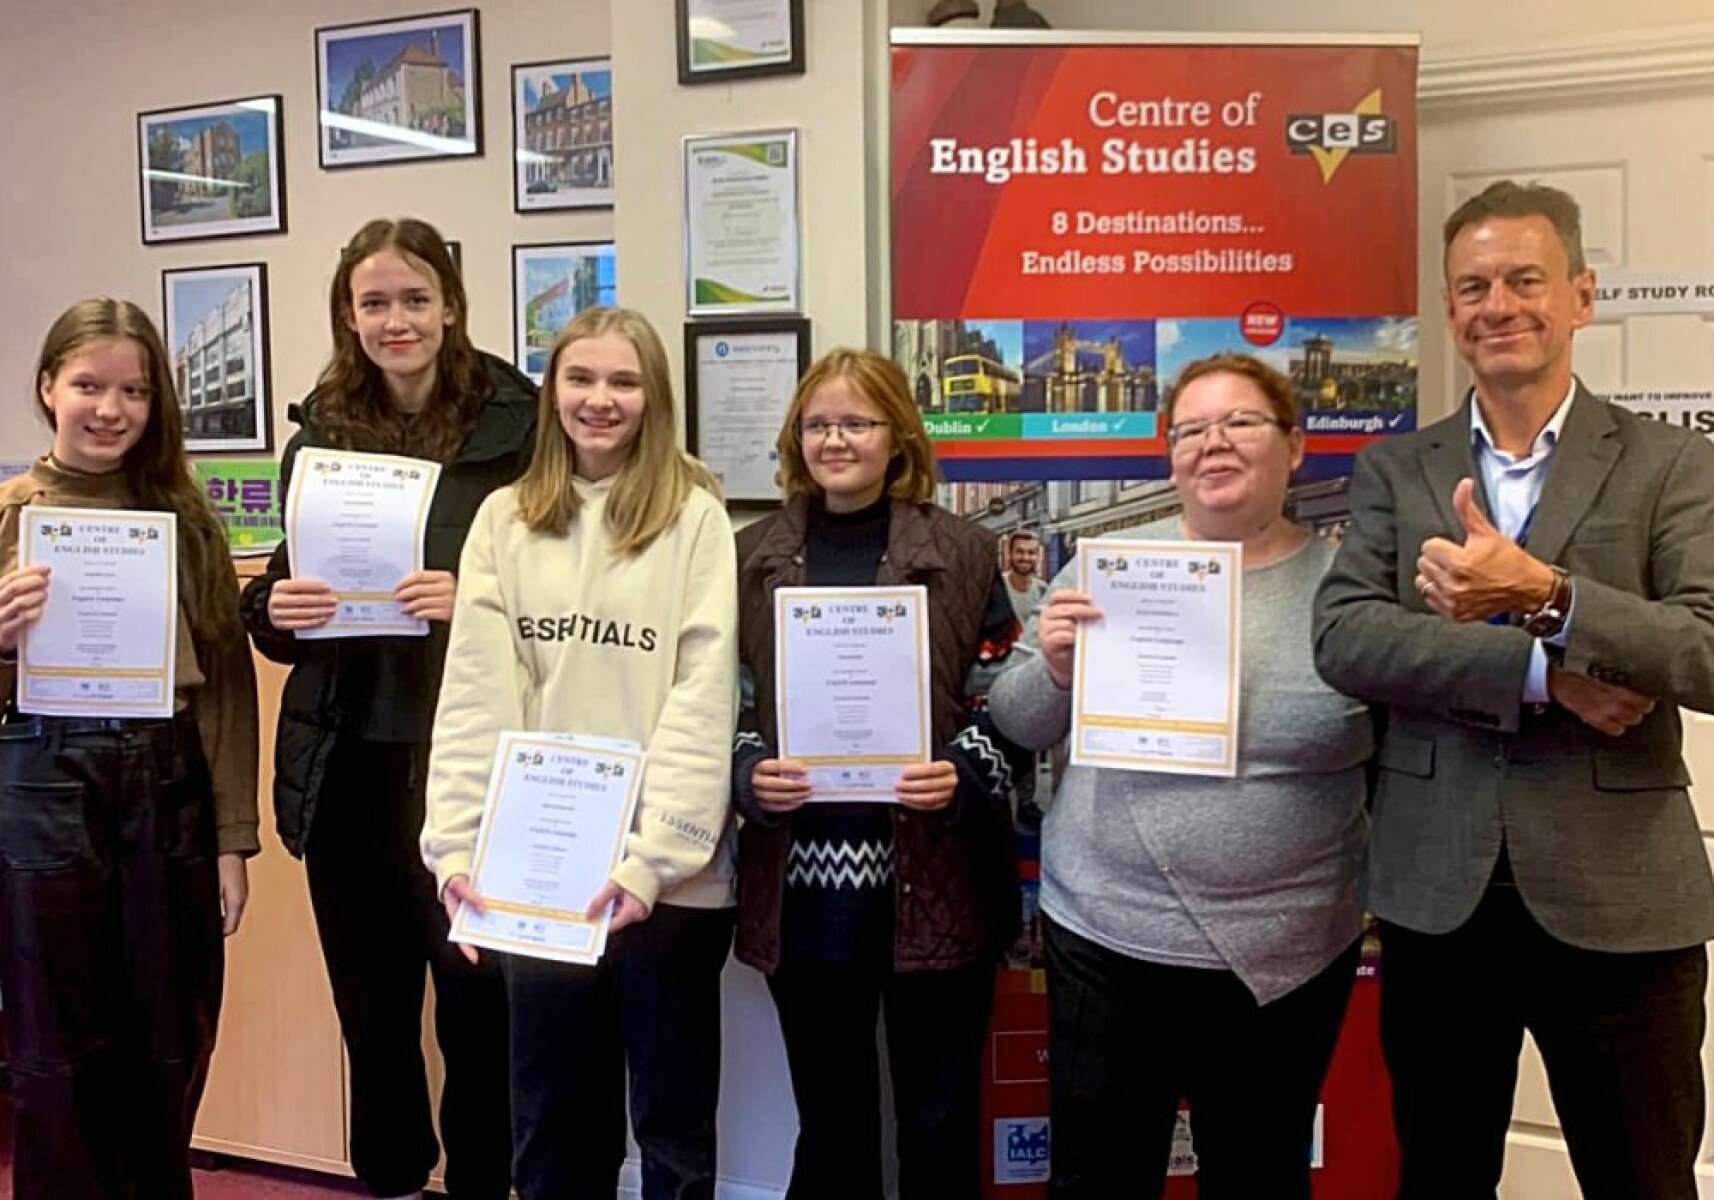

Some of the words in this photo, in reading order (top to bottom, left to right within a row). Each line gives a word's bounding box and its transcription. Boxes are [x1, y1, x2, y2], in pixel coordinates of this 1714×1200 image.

[1089, 92, 1210, 127] Centre
[1222, 92, 1261, 127] of
[1287, 119, 1388, 143] ces
[929, 139, 1087, 183] English
[1102, 139, 1257, 175] Studies
[1052, 212, 1068, 235] 8
[1077, 211, 1264, 235] Destinations...
[1022, 250, 1126, 275] Endless
[1133, 249, 1293, 274] Possibilities
[1596, 287, 1623, 301] ELF
[1628, 285, 1690, 300] STUDY
[1664, 392, 1712, 400] IMPROVE
[924, 420, 972, 435] Dublin
[1052, 419, 1109, 434] London
[1307, 415, 1384, 432] Edinburgh
